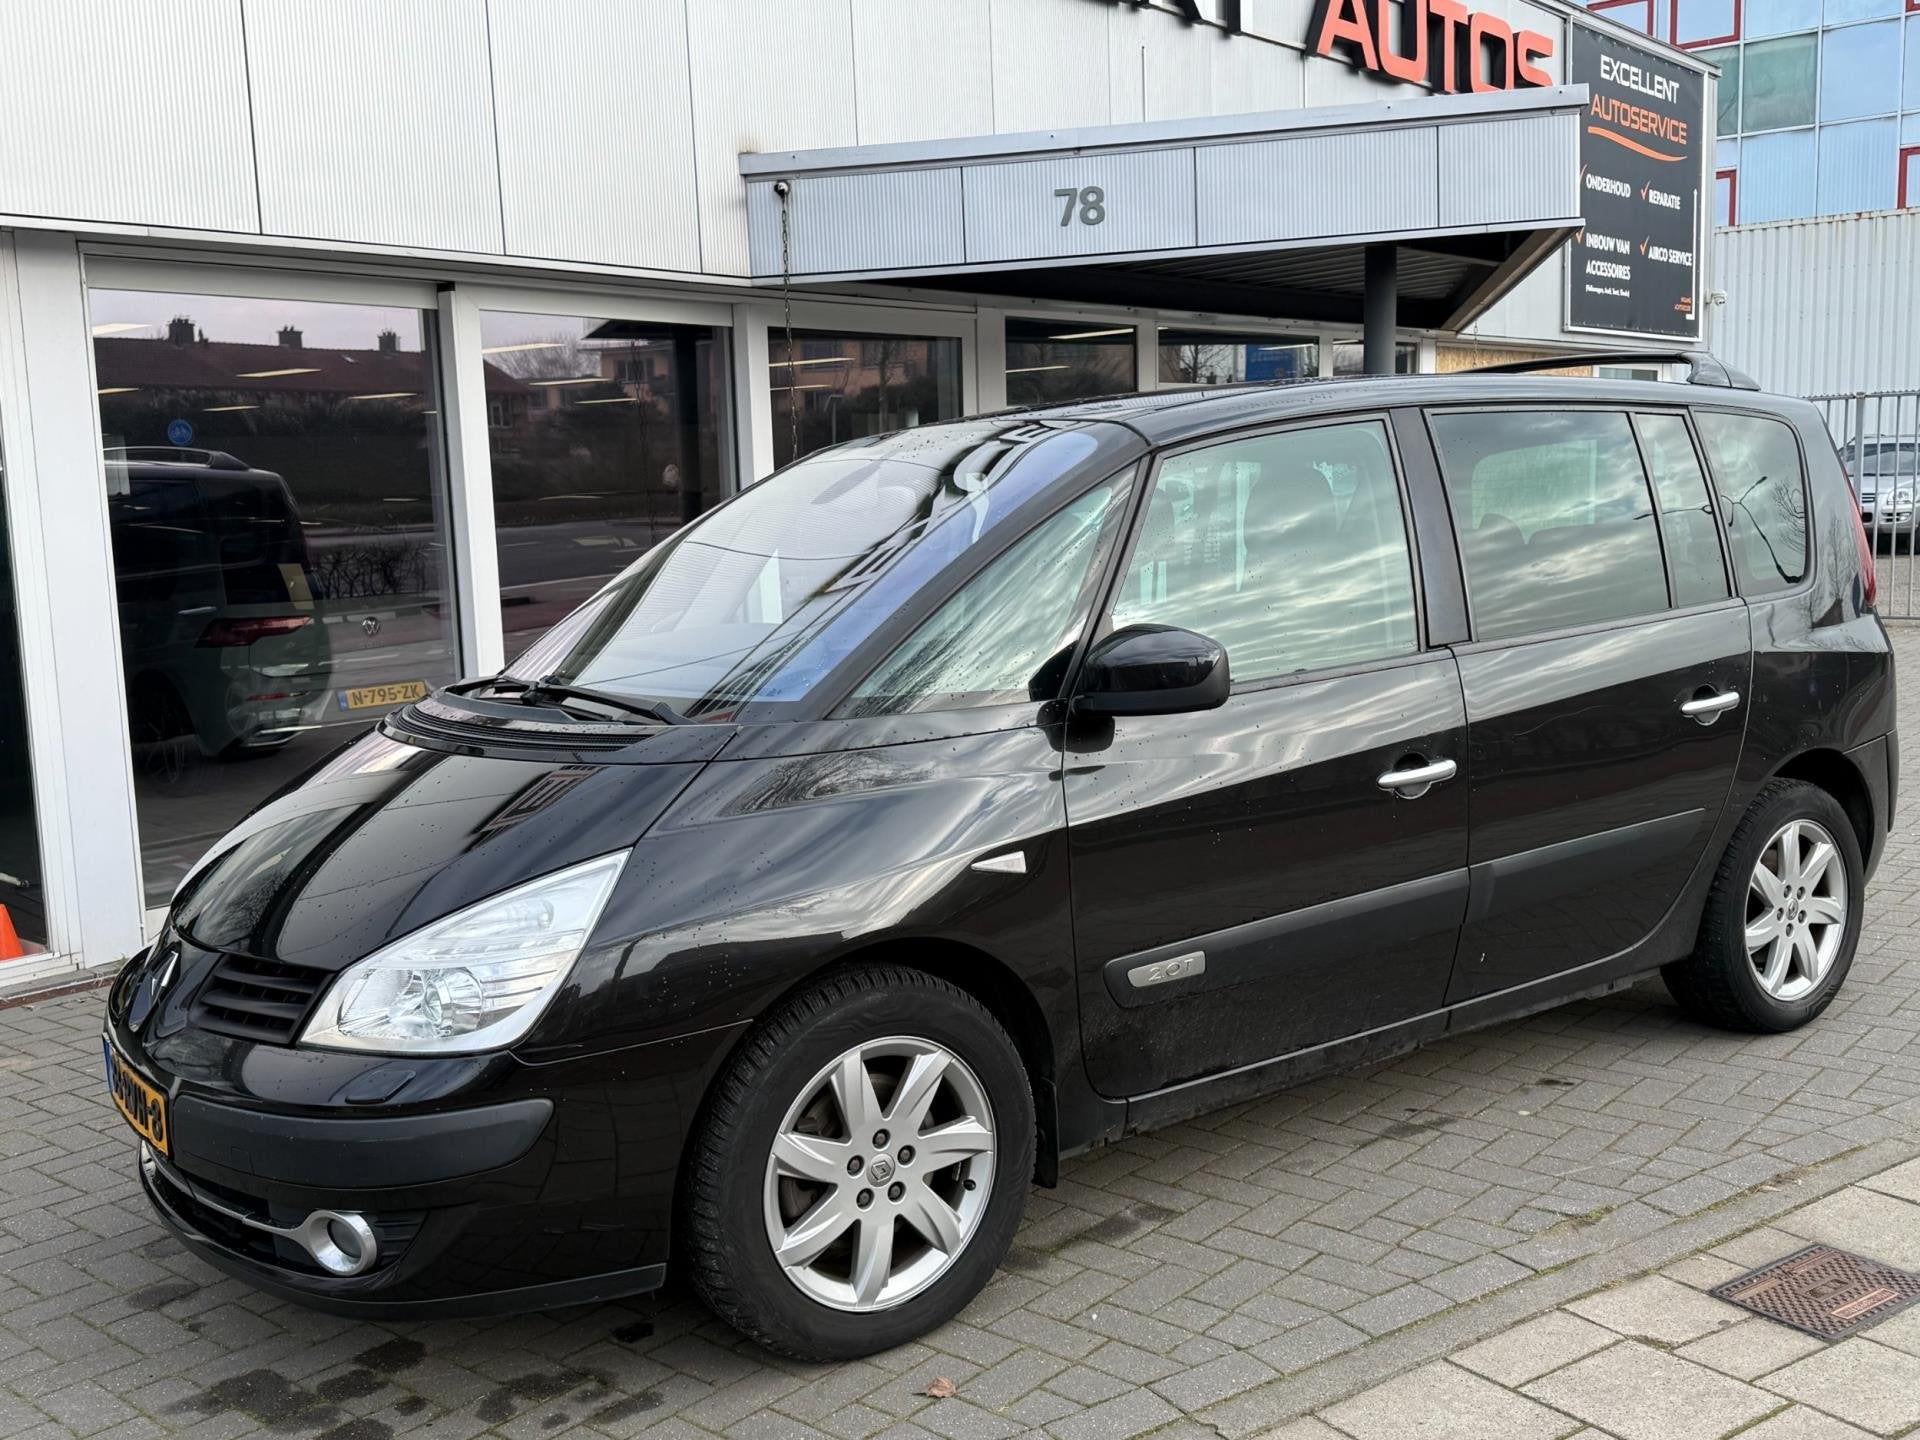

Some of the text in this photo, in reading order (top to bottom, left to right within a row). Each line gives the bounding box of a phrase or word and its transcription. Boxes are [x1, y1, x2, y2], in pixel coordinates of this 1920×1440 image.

[1315, 0, 1554, 94] AUTOS
[1600, 54, 1680, 105] EXCELLENT
[1590, 93, 1687, 145] AUTOSERVICE
[1585, 173, 1631, 198] ONDERHOUD
[1054, 185, 1106, 227] 78
[1648, 189, 1681, 210] REPARATIE
[1585, 232, 1631, 255] INBOUW VAN
[1647, 245, 1693, 267] AIRCO SERVICE
[1585, 259, 1631, 281] ACCESSOIRES
[351, 684, 421, 706] N-795-ZK
